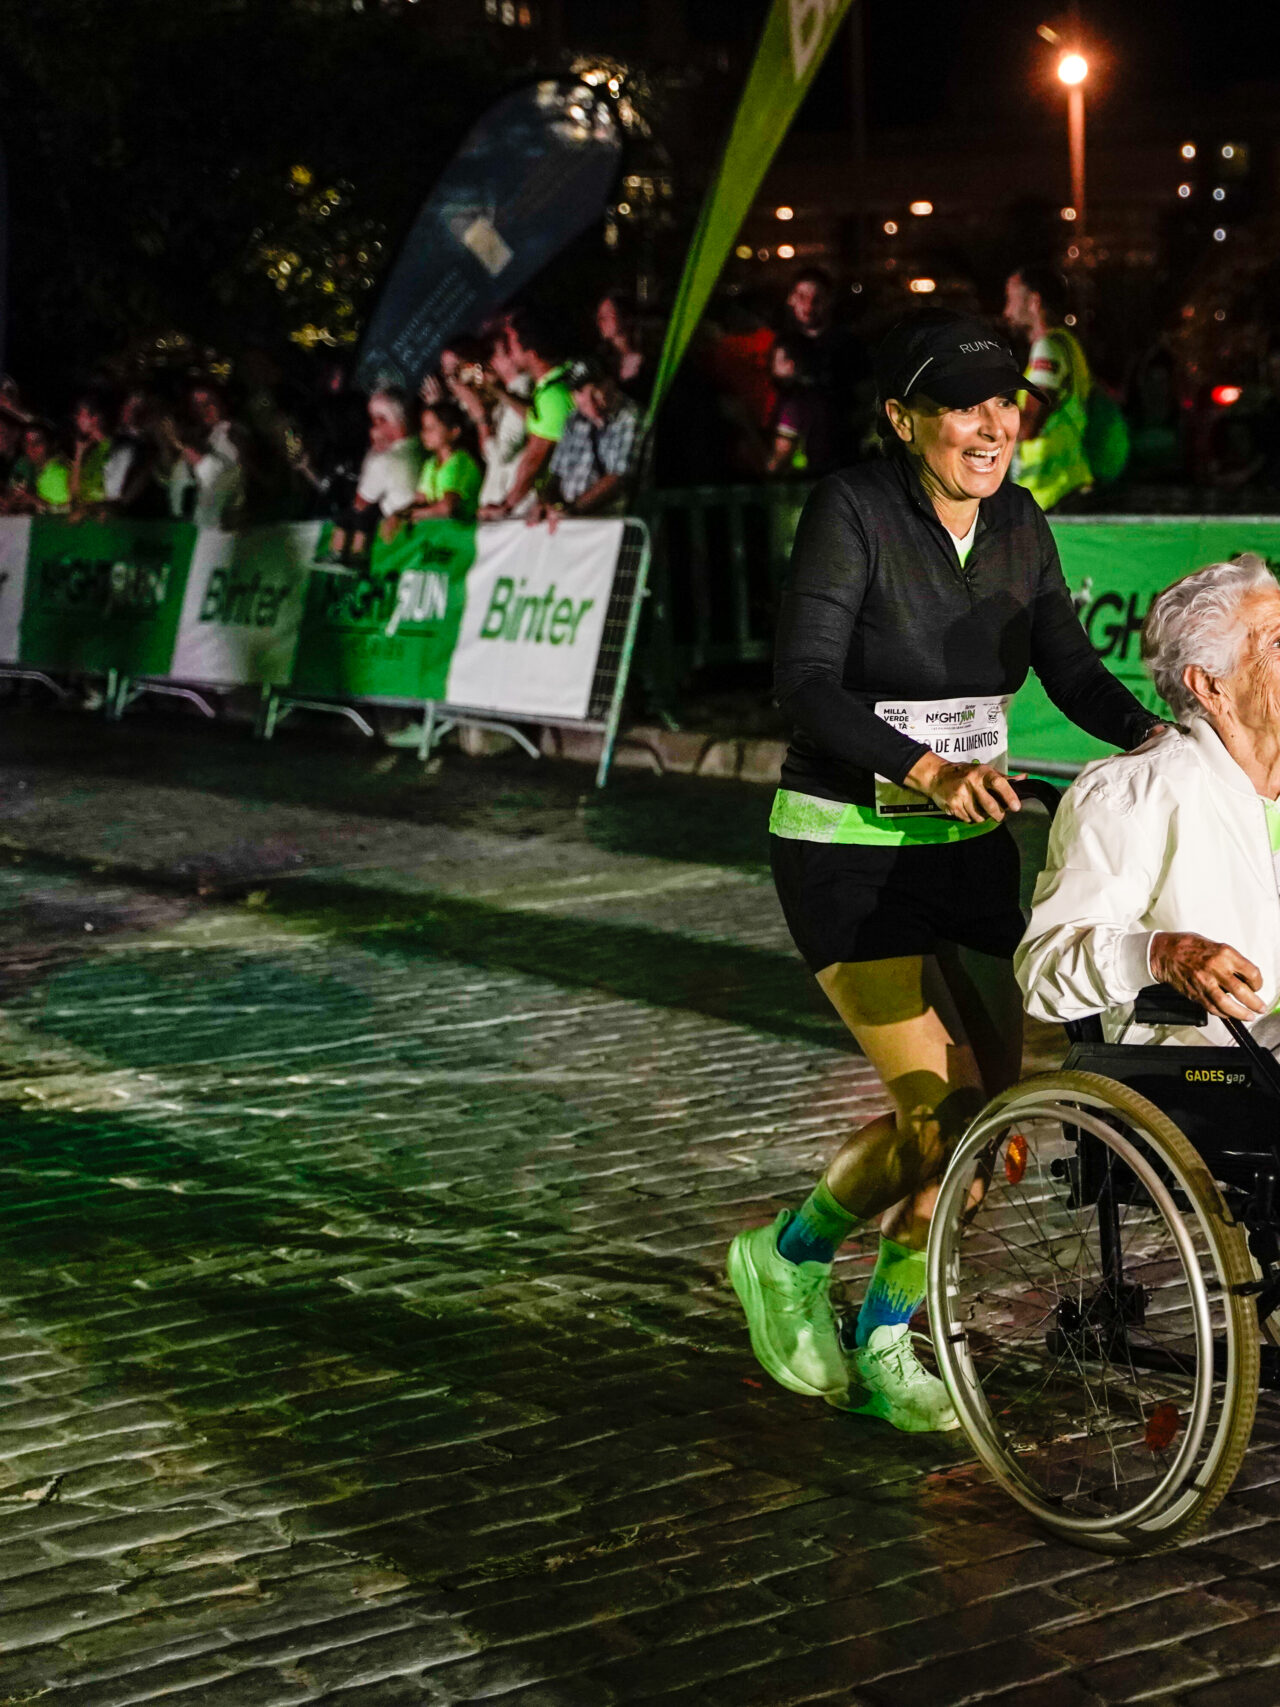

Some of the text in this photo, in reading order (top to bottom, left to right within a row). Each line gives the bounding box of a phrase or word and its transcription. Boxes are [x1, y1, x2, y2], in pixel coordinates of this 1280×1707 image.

[480, 576, 594, 645] Binter
[936, 738, 950, 753] DE
[953, 730, 999, 753] ALIMENTOS
[1185, 1069, 1245, 1084] GADES gap
